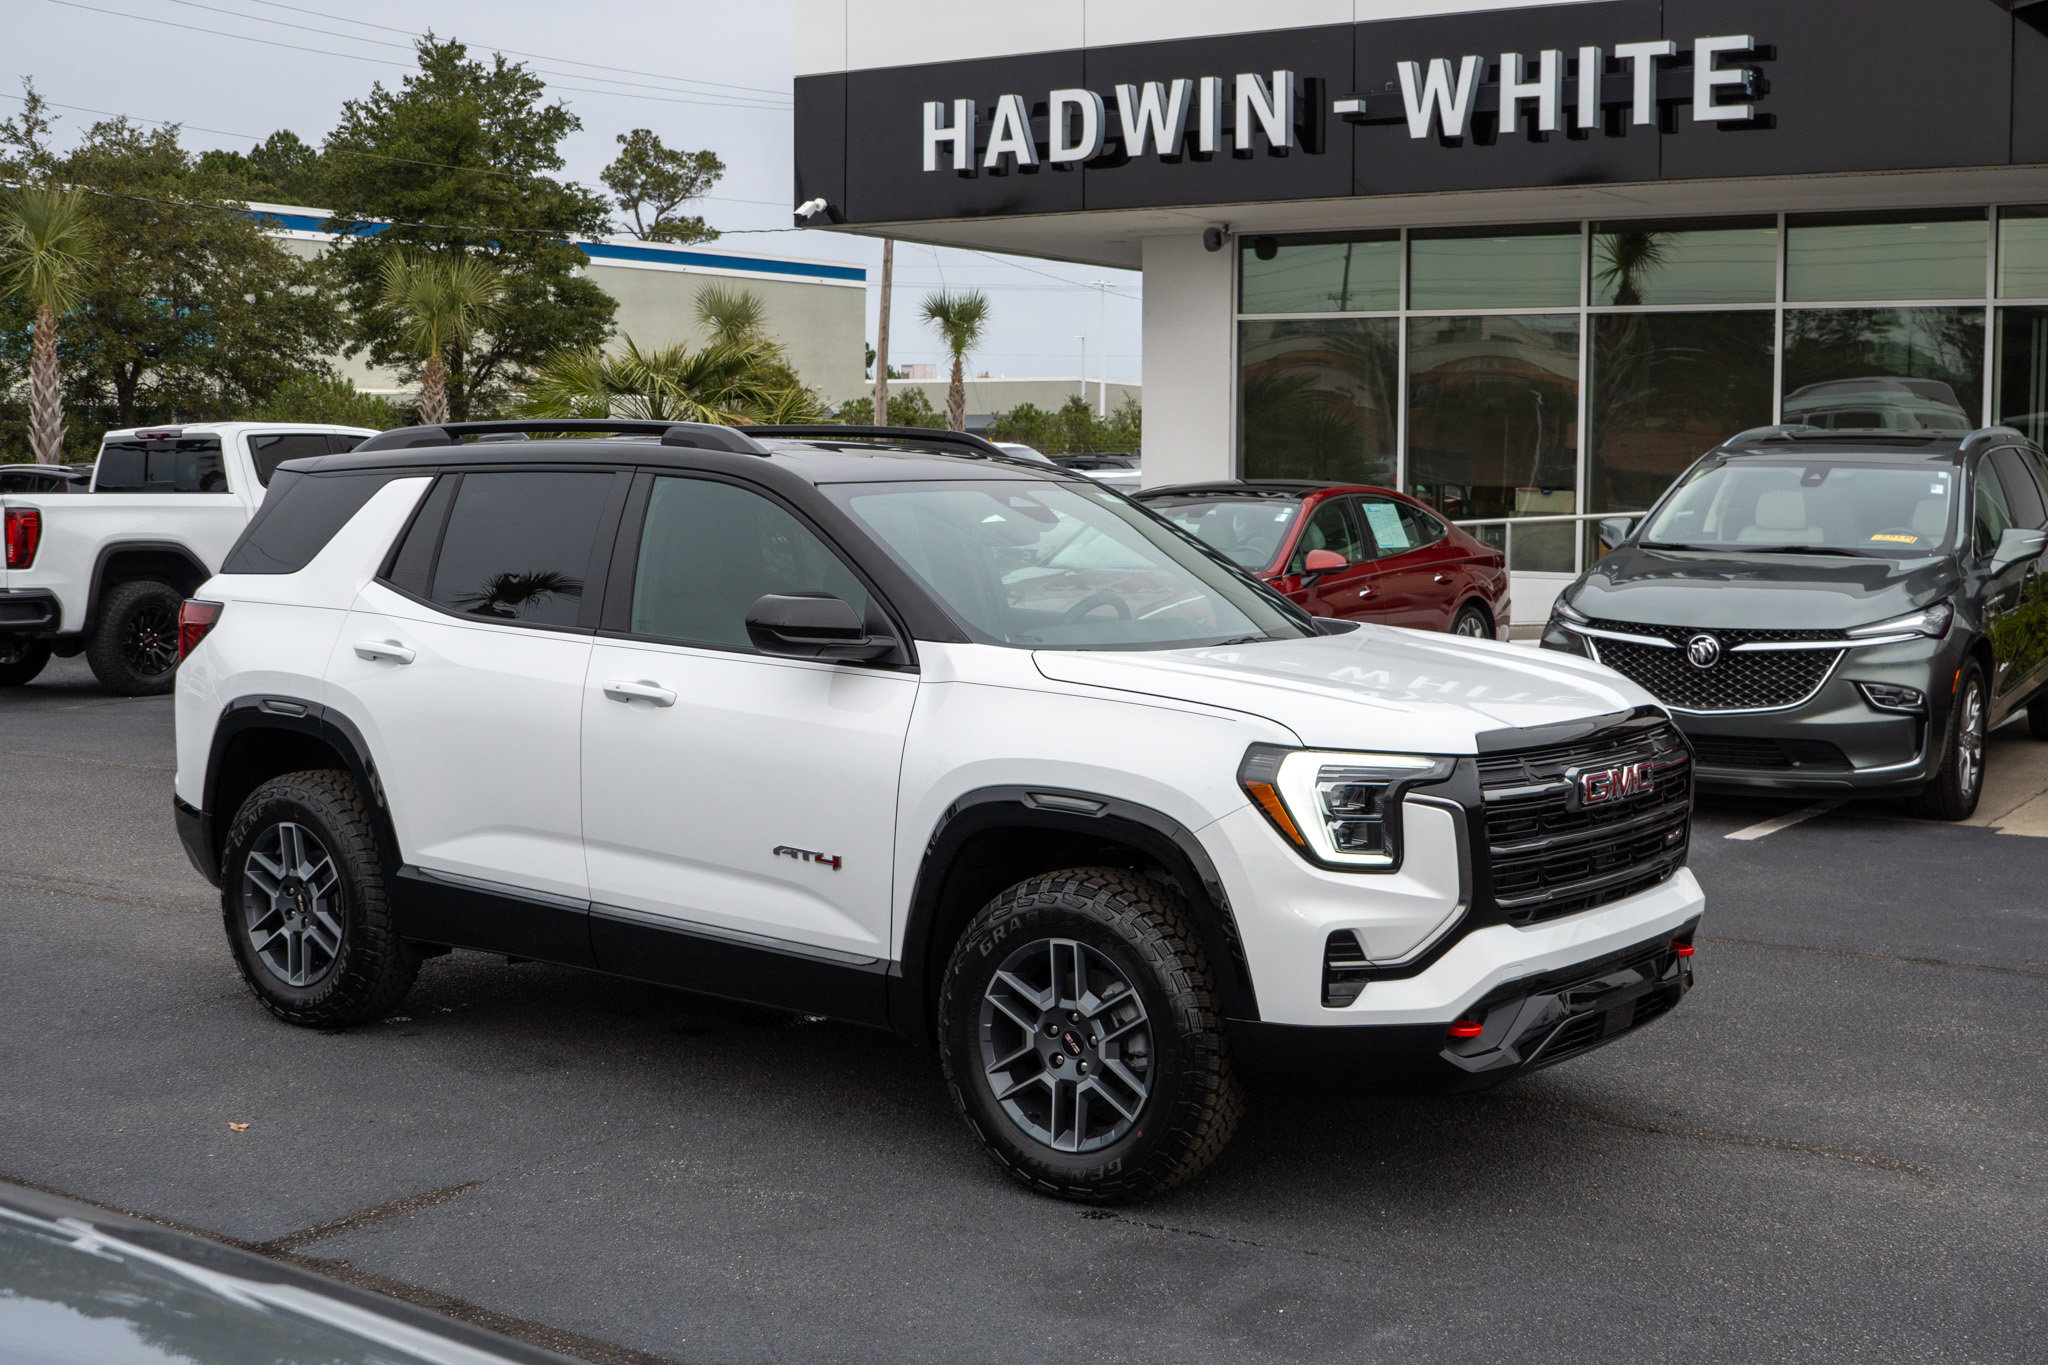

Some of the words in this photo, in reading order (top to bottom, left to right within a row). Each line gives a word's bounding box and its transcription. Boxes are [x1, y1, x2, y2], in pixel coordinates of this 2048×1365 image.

[923, 70, 1294, 172] HADWIN
[1398, 35, 1755, 139] WHITE
[1583, 763, 1654, 805] GMC
